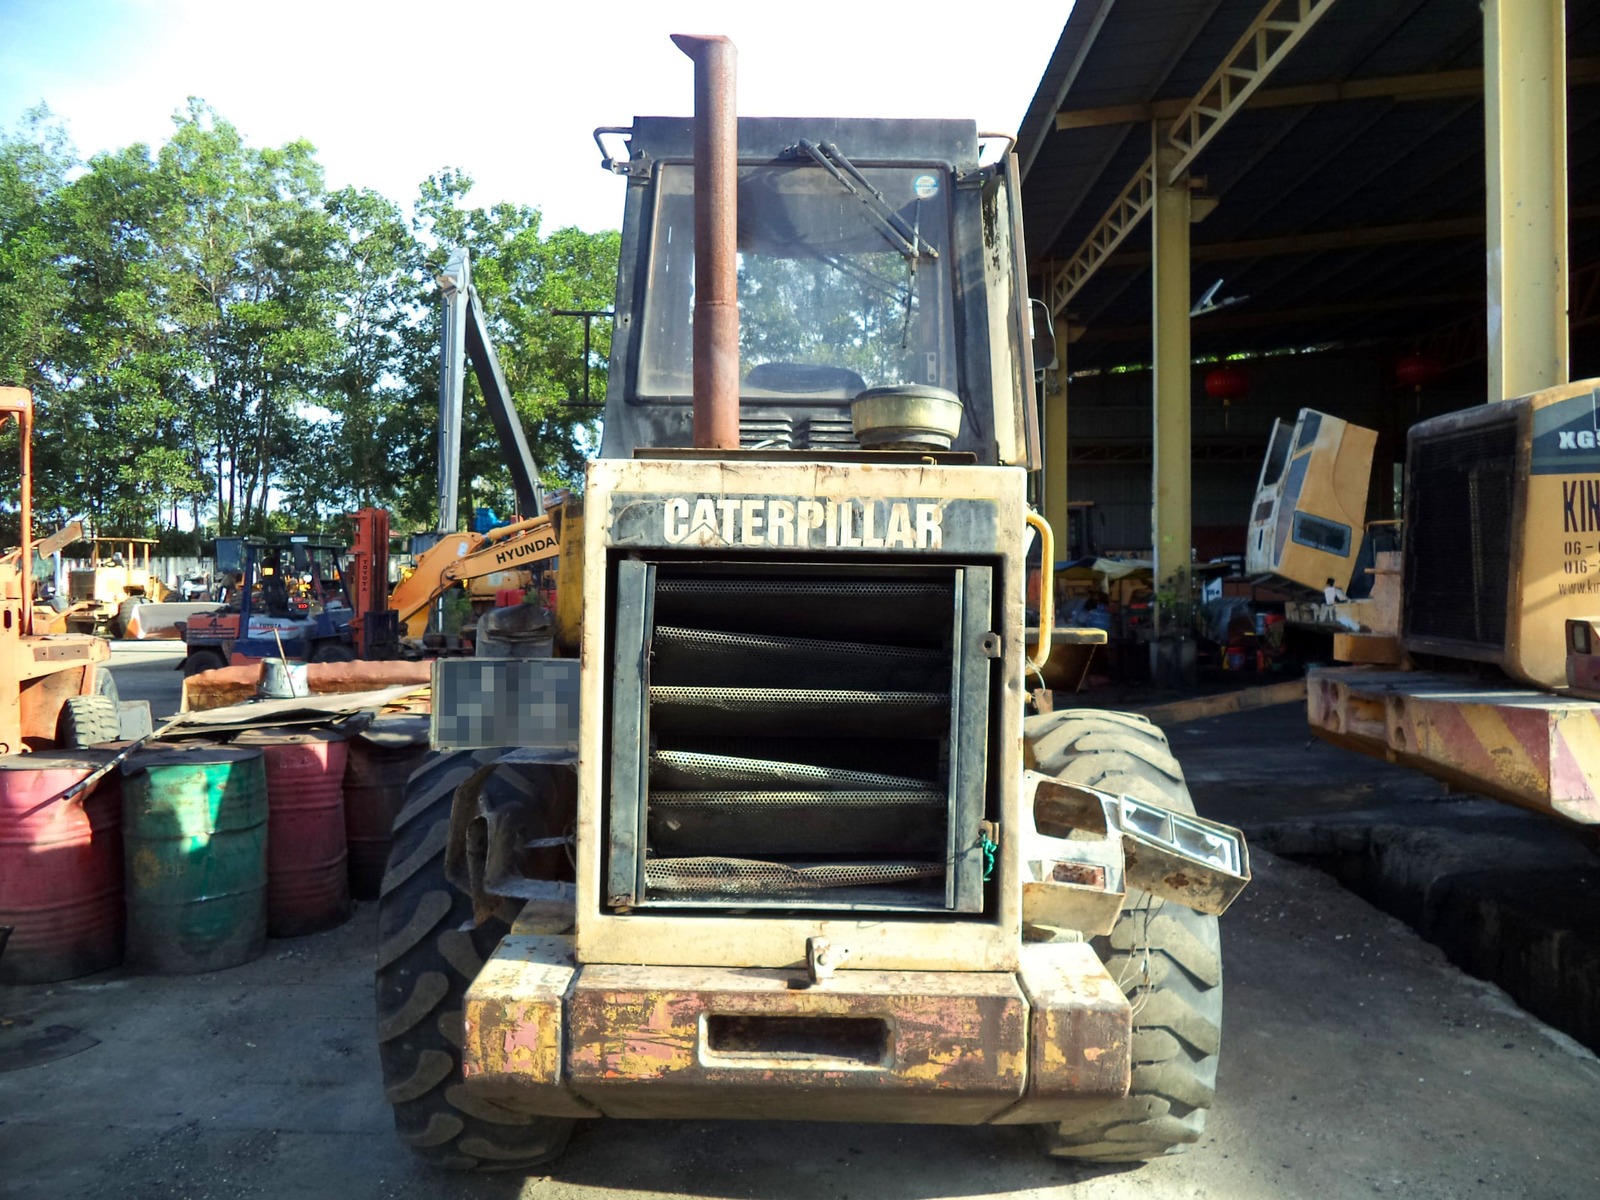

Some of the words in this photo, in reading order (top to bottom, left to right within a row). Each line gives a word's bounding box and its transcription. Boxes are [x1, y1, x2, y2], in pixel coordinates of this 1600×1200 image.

[1559, 431, 1600, 449] XG
[663, 497, 944, 549] CATERPILLAR
[1564, 541, 1600, 556] 06-
[361, 559, 369, 592] TOYOTA
[1564, 560, 1600, 574] 016-
